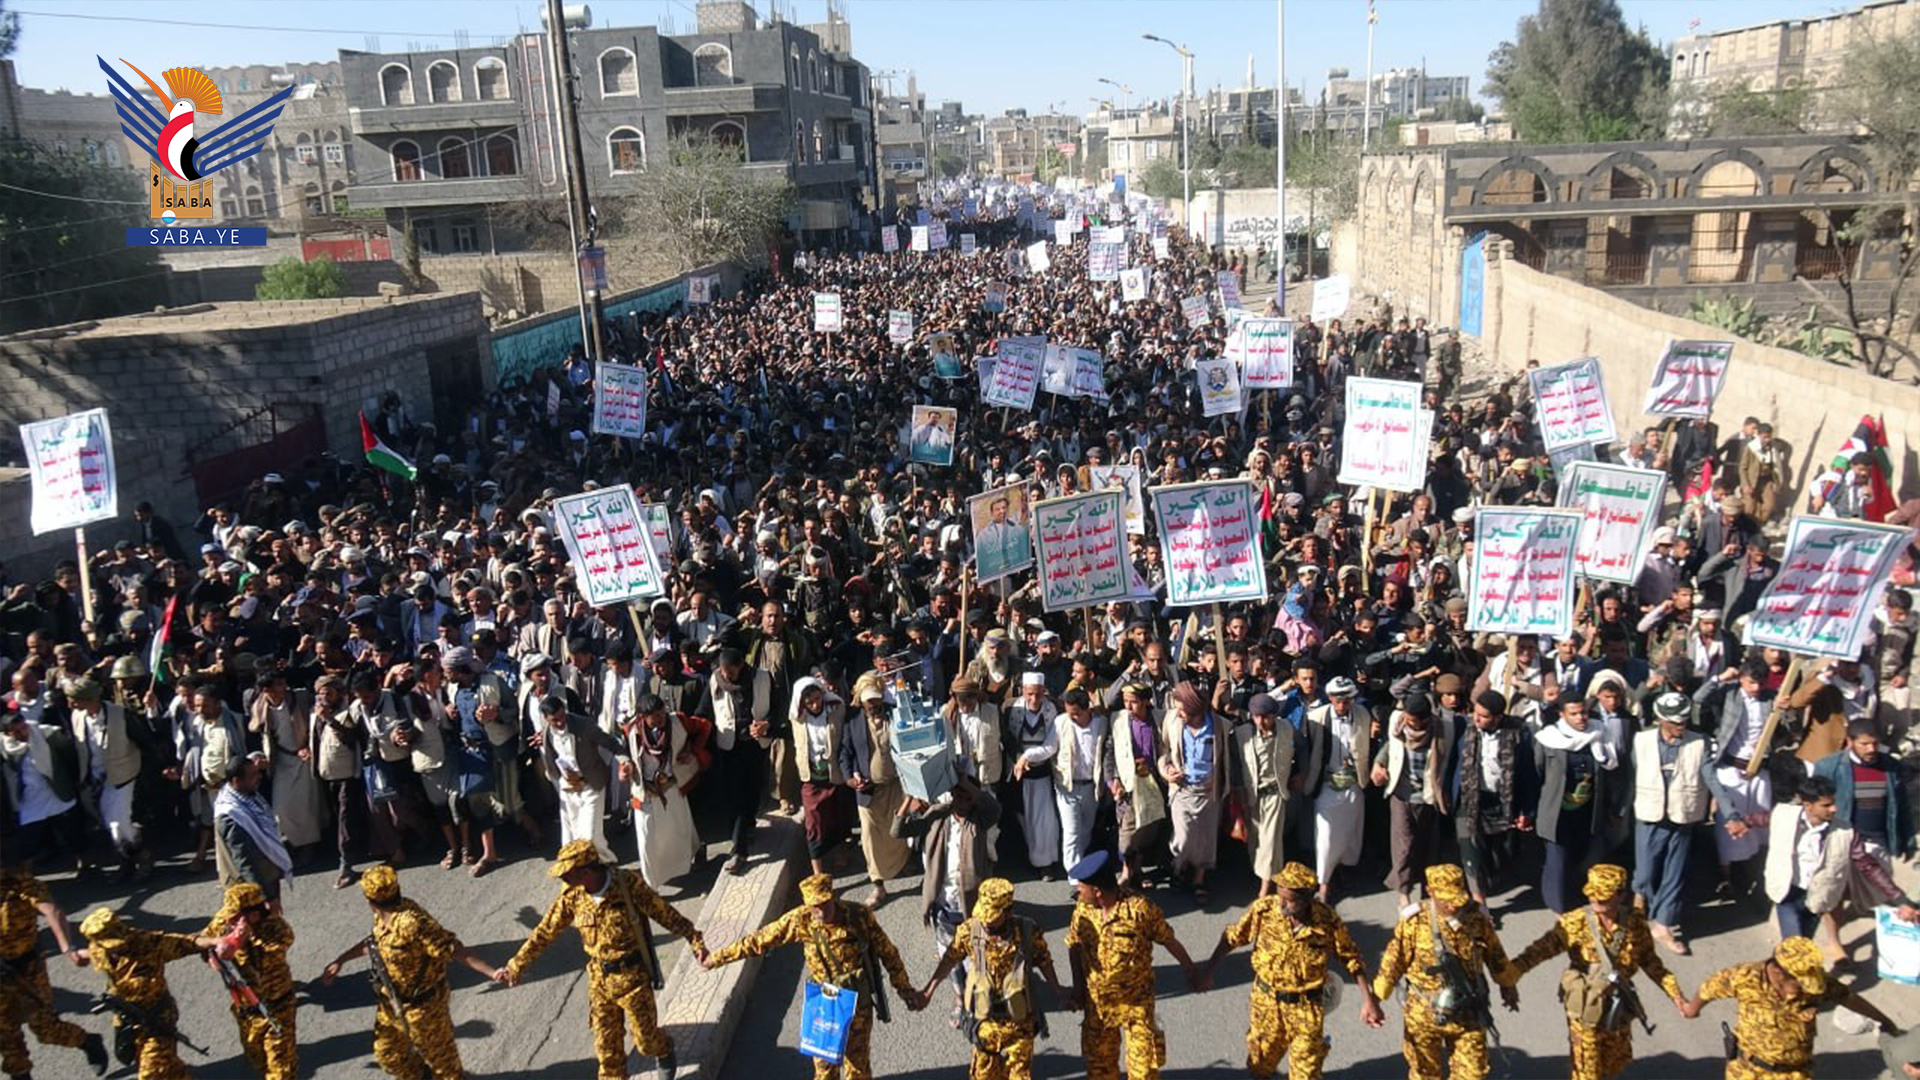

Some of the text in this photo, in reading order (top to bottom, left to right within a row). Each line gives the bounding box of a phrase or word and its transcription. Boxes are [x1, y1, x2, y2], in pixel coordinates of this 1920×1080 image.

[1354, 392, 1412, 409] قاطعوا
[1576, 474, 1652, 500] قاطعوا
[607, 497, 629, 514] الله
[1214, 489, 1244, 506] الله
[1088, 499, 1114, 516] الله
[609, 518, 636, 534] الموت
[1212, 508, 1246, 528] الموت
[1085, 519, 1115, 536] الموت
[1538, 521, 1571, 538] الله
[615, 537, 642, 552] الموت
[1087, 537, 1116, 555] الموت
[1215, 527, 1249, 548] الموت
[1531, 546, 1567, 562] الموت
[614, 560, 625, 573] على
[1077, 562, 1092, 576] على
[1205, 555, 1221, 572] على
[627, 570, 653, 593] النصر
[1221, 568, 1256, 594] النصر
[1528, 566, 1564, 582] الموت
[1090, 571, 1121, 596] النصر
[1513, 590, 1532, 604] على
[1524, 607, 1562, 630] النصر
